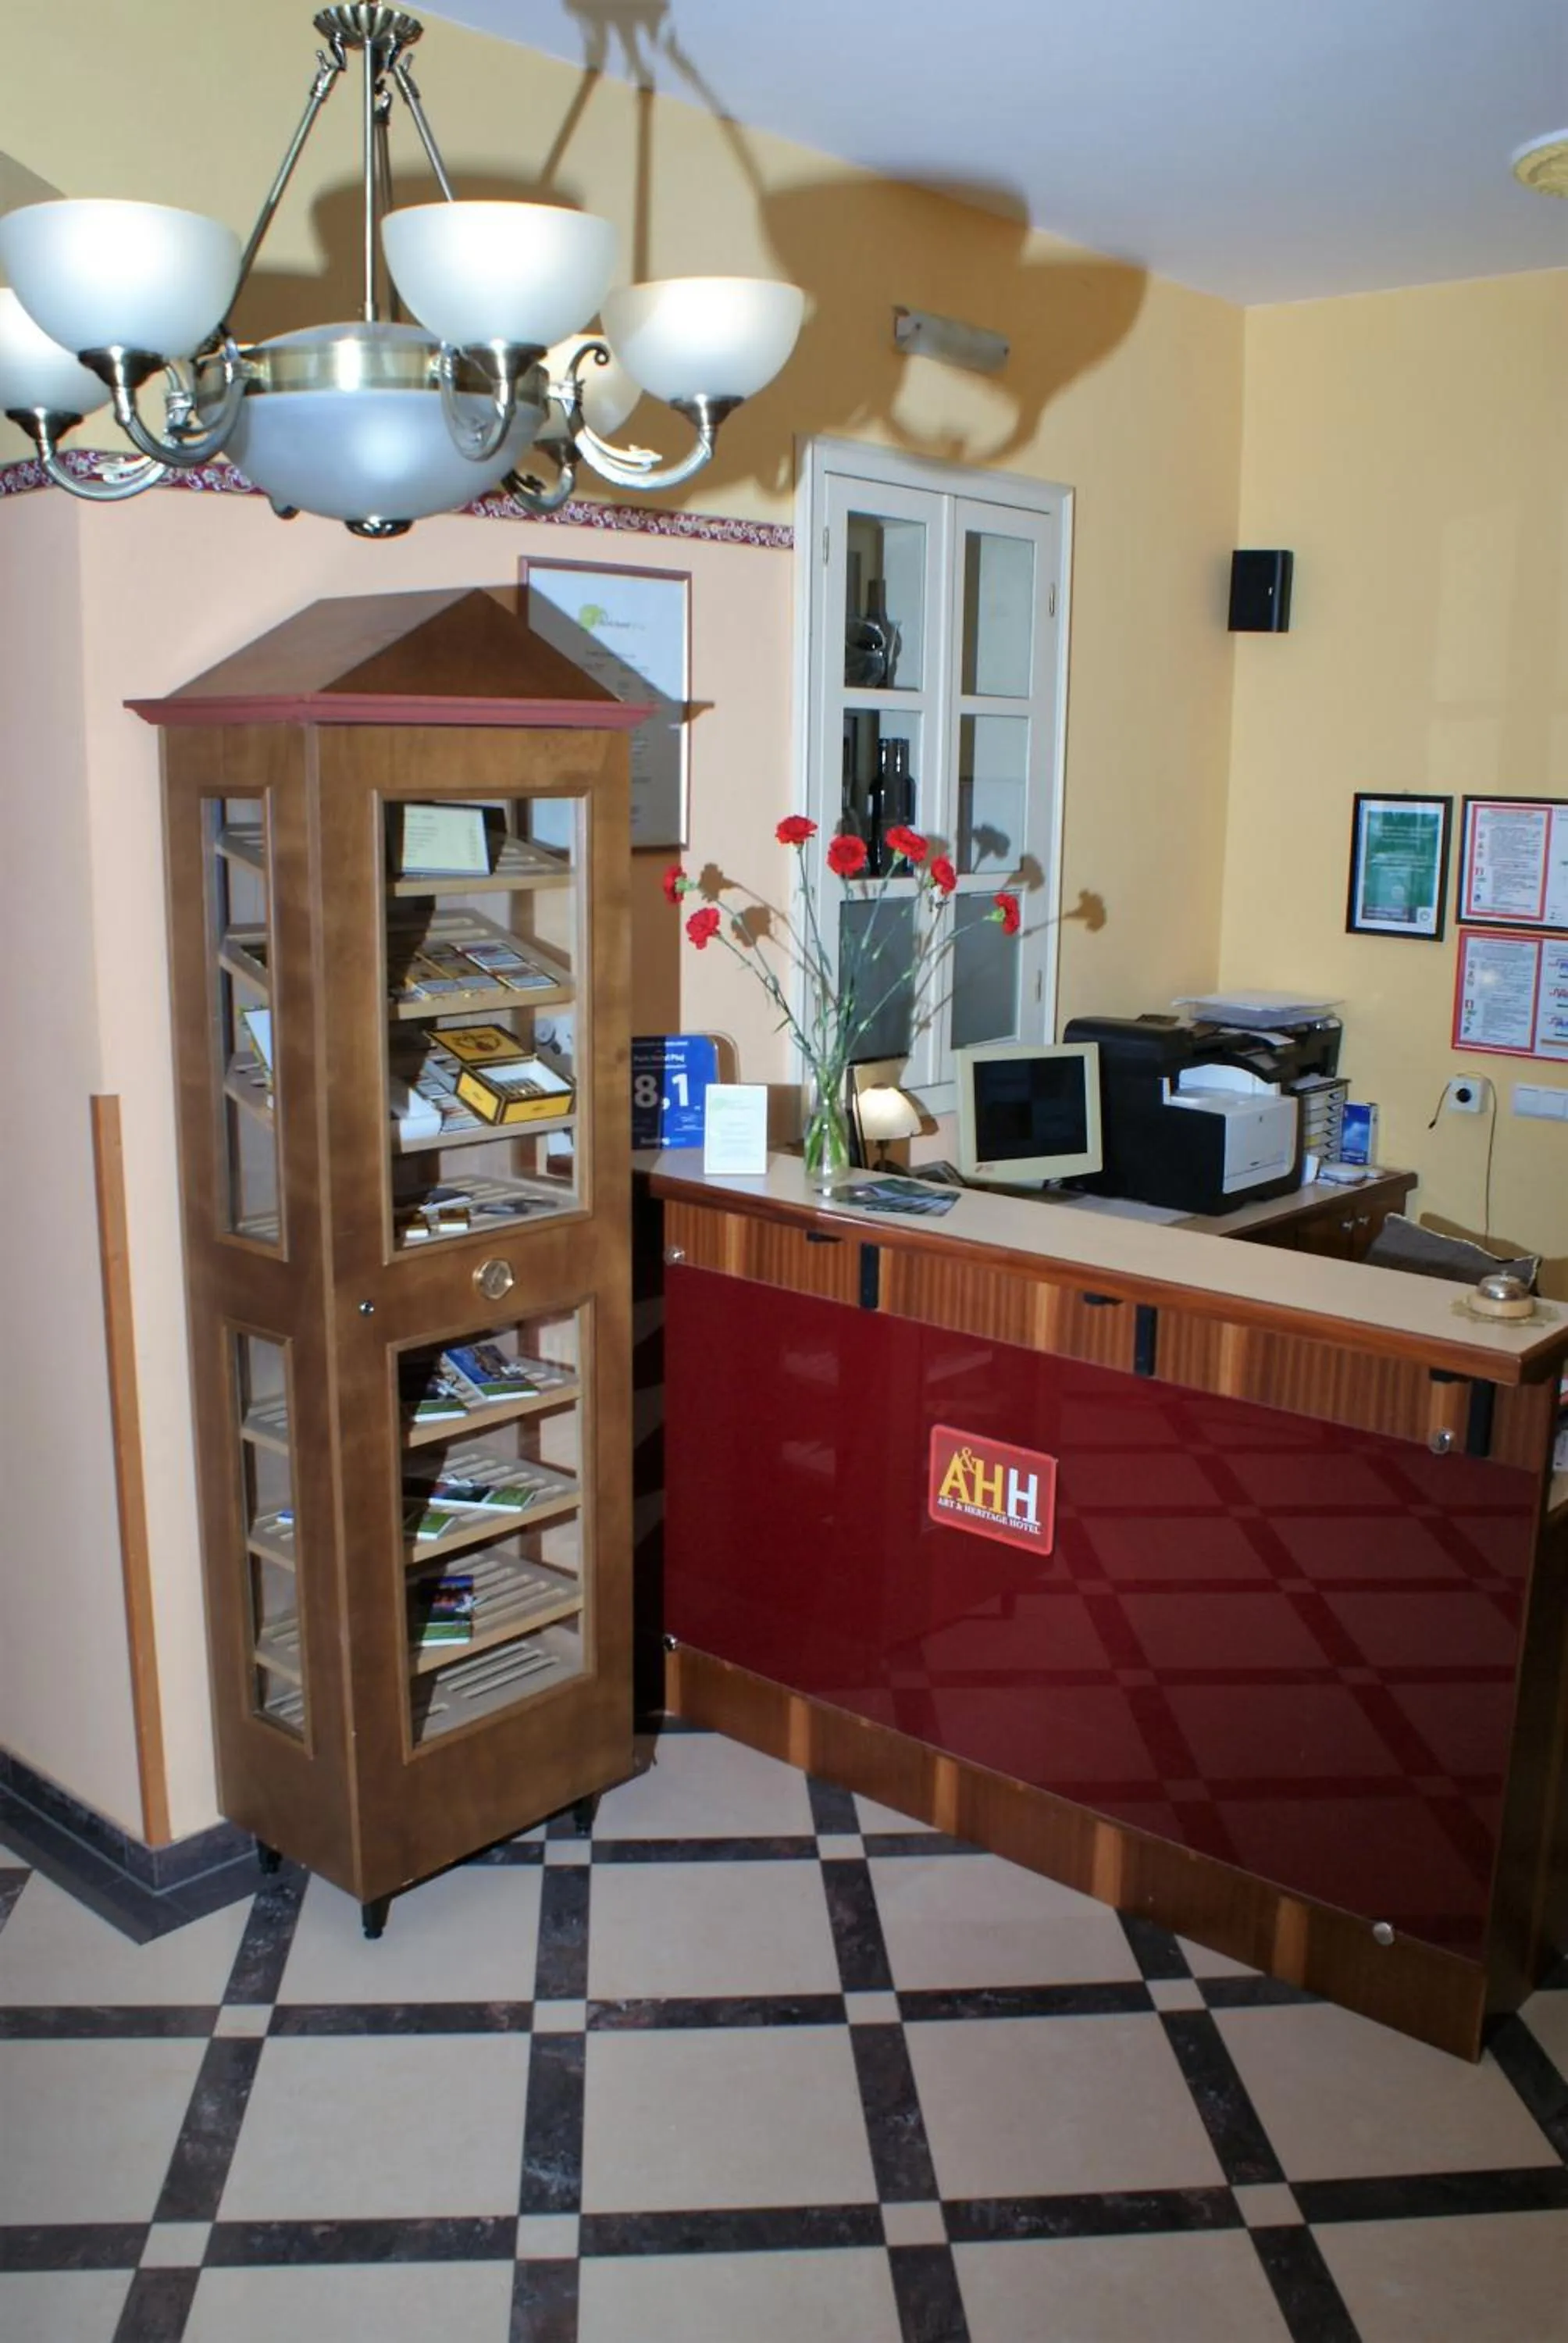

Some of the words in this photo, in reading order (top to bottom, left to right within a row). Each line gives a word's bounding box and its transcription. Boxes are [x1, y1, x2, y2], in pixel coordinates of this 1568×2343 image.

[634, 1073, 689, 1110] 8,1
[937, 1497, 954, 1508] ART
[964, 1504, 1007, 1525] HERITAGE
[1009, 1517, 1041, 1535] HOTEL
